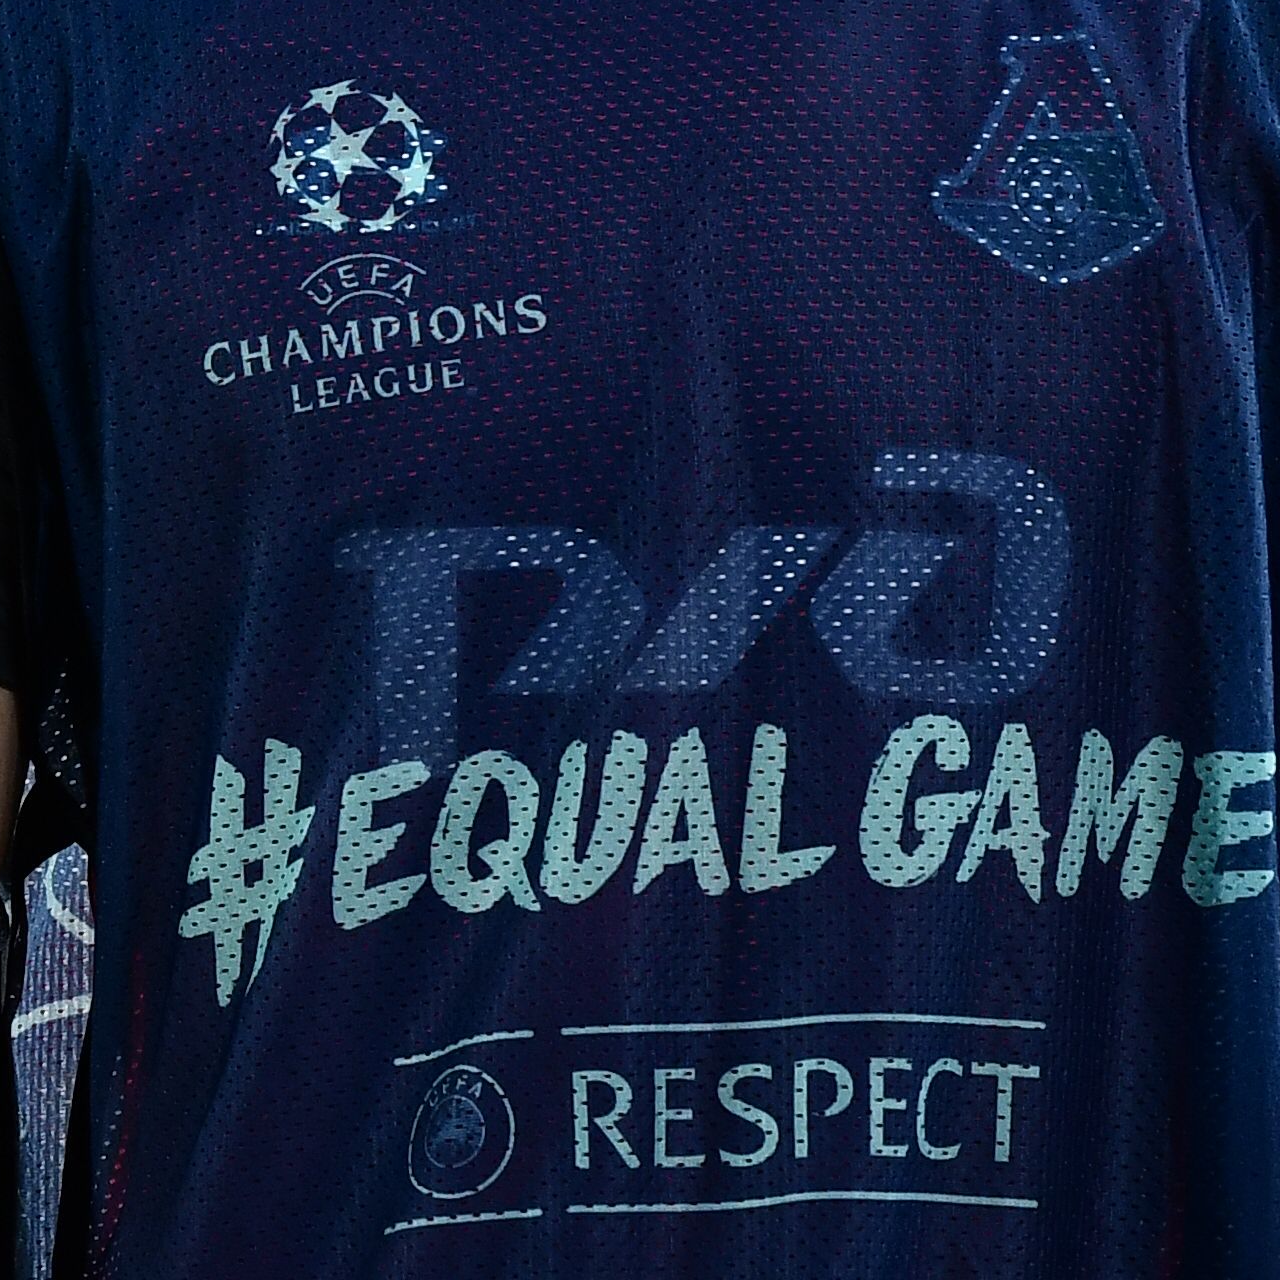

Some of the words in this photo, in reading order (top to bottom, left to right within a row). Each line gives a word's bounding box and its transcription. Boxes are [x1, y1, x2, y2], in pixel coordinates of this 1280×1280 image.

[307, 263, 415, 306] UEFA
[203, 293, 548, 387] CHAMPIONS
[290, 358, 465, 415] LEAGUE
[571, 1057, 1040, 1170] RESPECT
